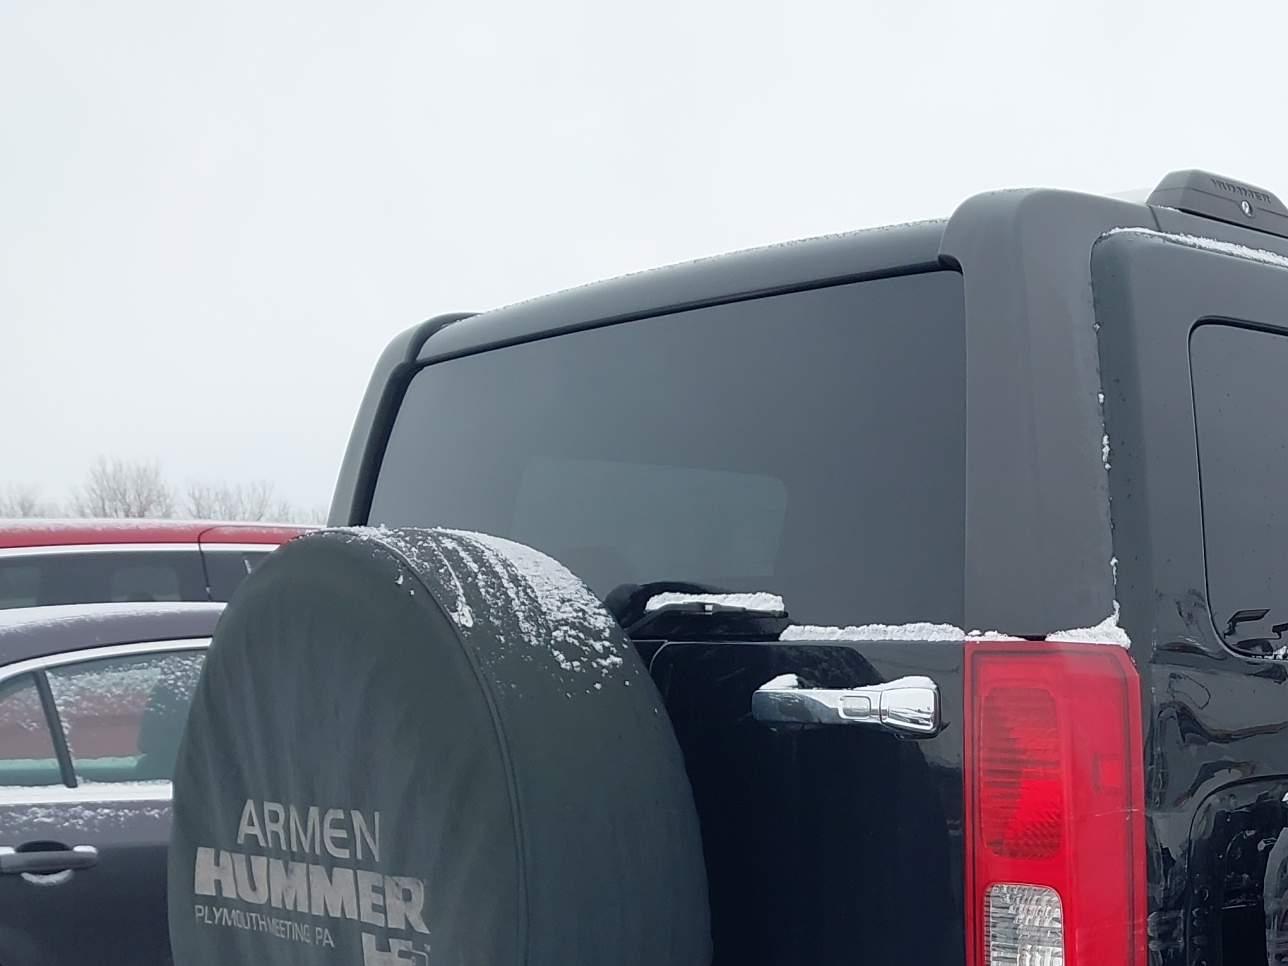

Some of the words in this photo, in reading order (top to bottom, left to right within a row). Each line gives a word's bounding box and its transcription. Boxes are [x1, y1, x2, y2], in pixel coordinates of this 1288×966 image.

[236, 798, 381, 863] ARMEN
[193, 846, 432, 935] HUMMER
[194, 904, 268, 933] PLYMOUTH
[315, 926, 336, 949] PA
